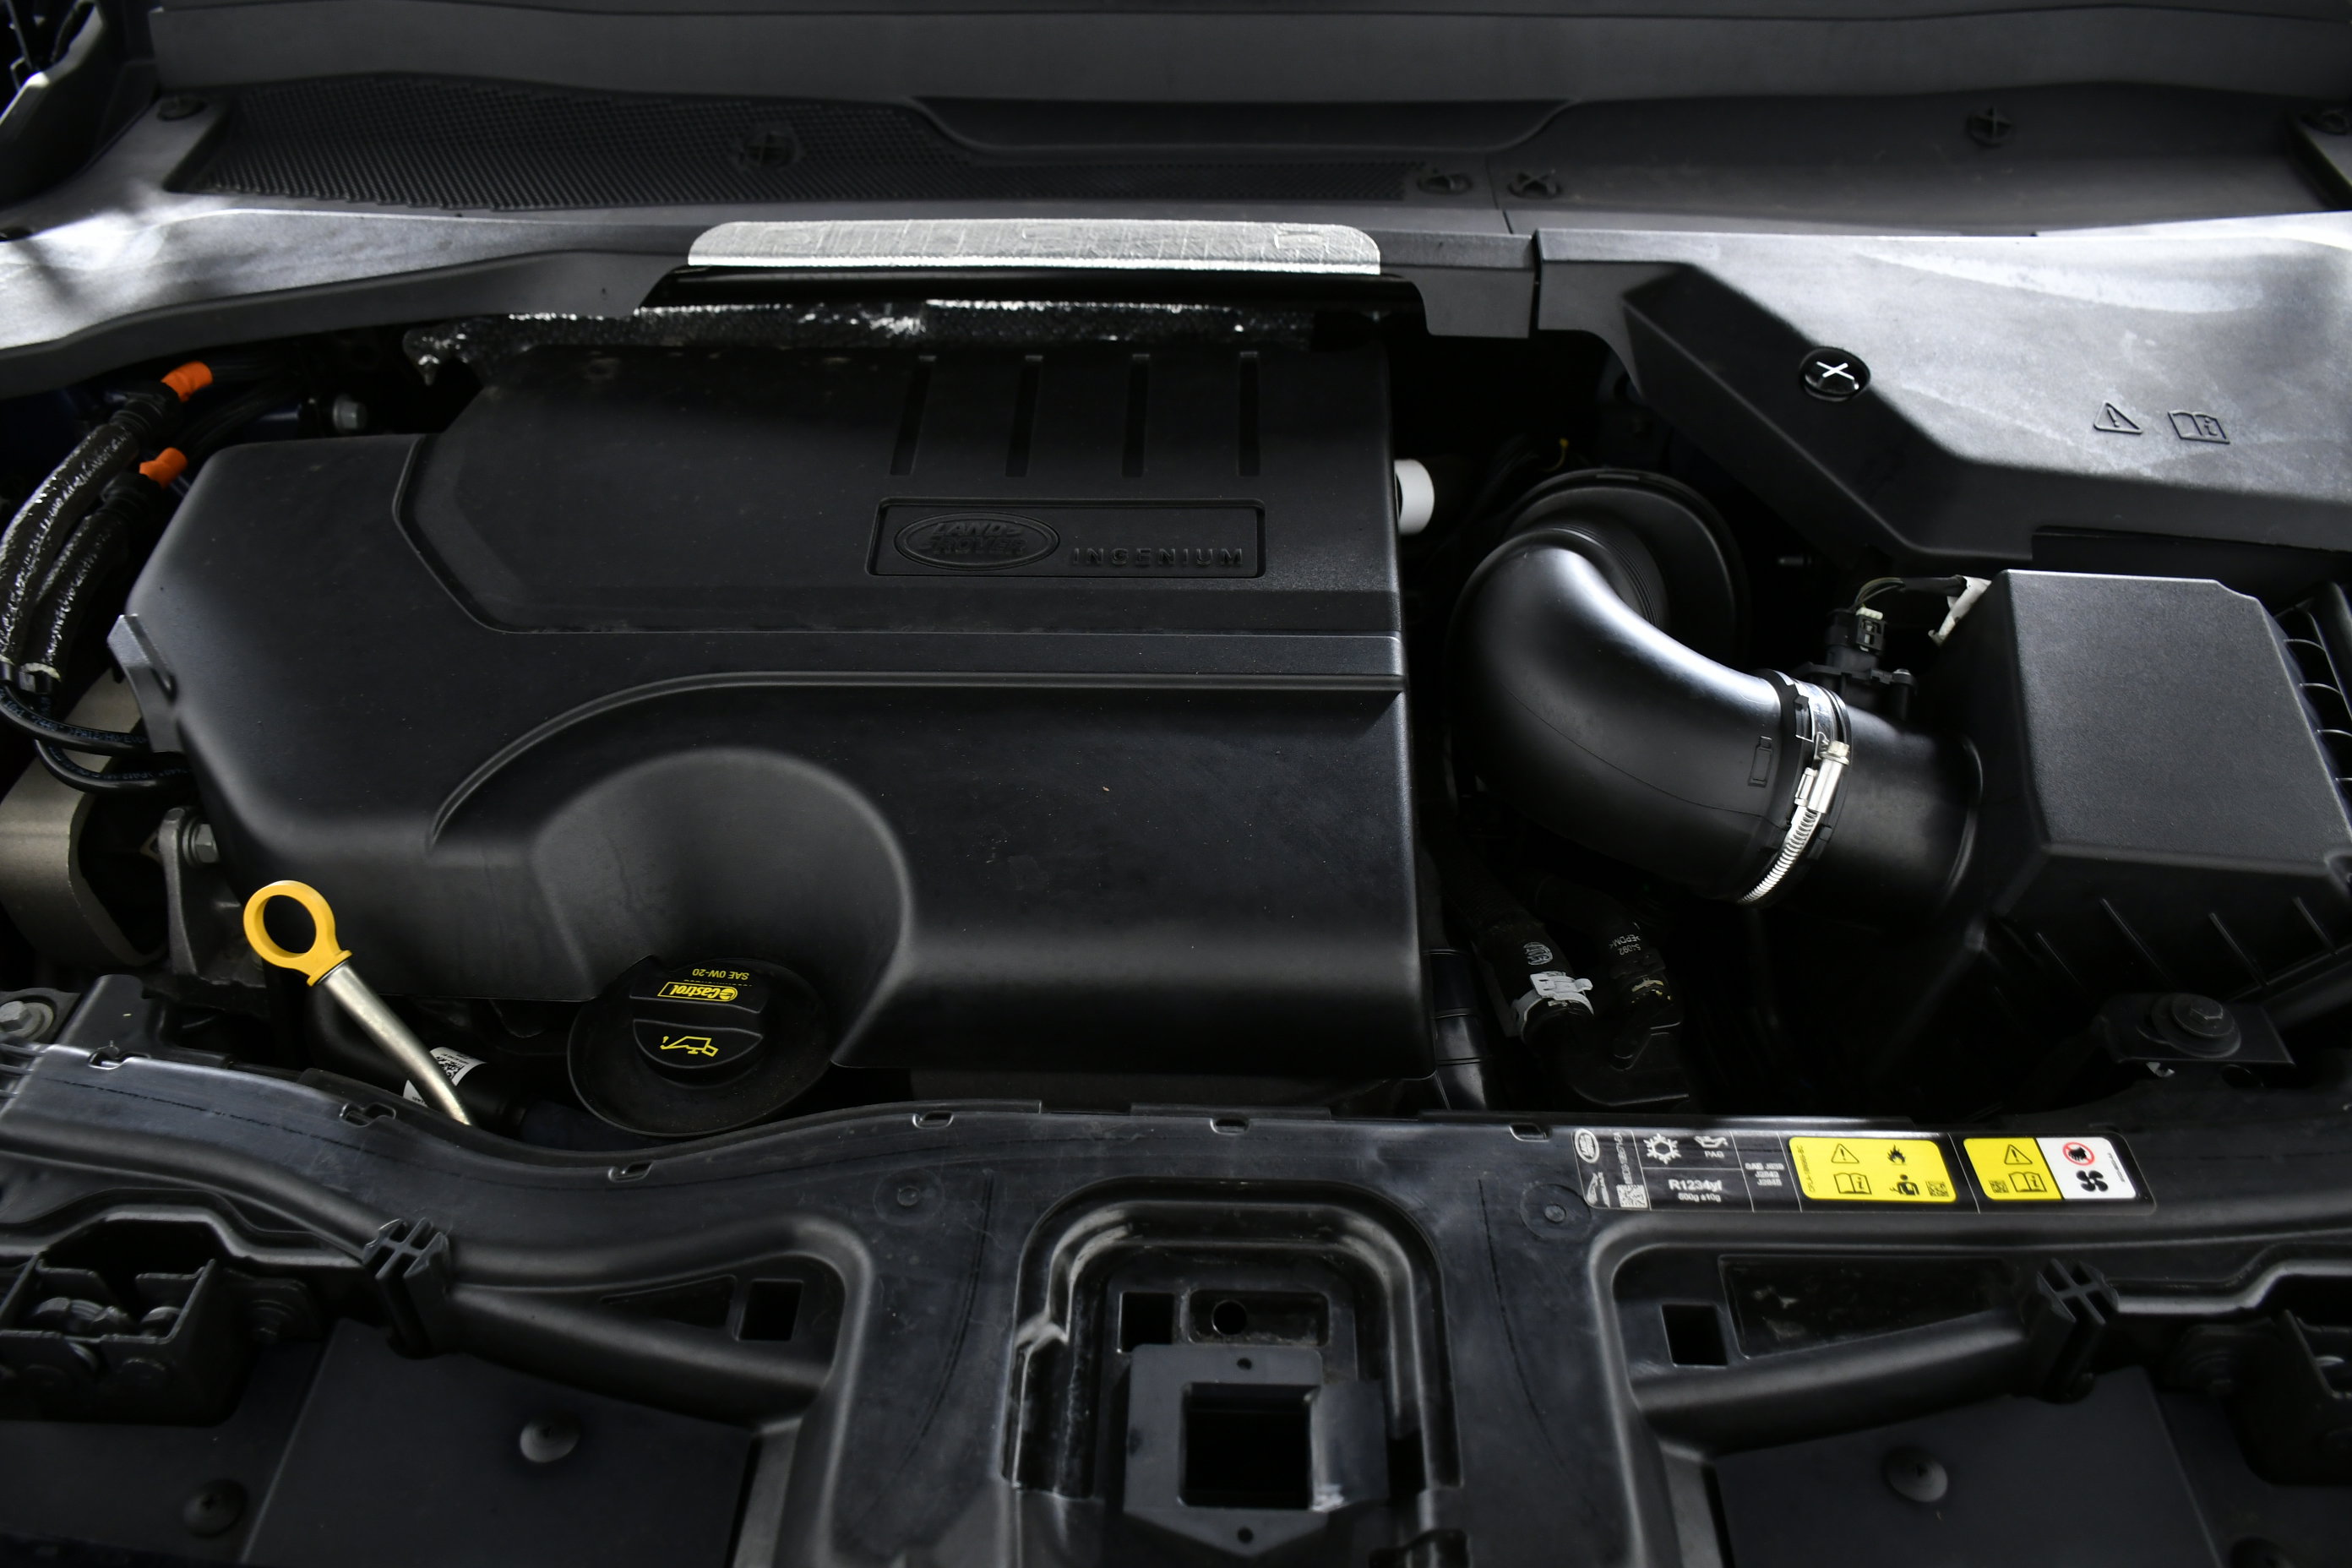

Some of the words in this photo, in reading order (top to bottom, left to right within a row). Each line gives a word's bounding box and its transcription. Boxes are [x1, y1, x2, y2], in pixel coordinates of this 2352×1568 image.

[1072, 547, 1244, 567] INGENIUM
[692, 968, 726, 978] 0W-20
[727, 972, 749, 980] SAE
[669, 985, 721, 999] Castrol
[1668, 1179, 1723, 1192] R1234yf
